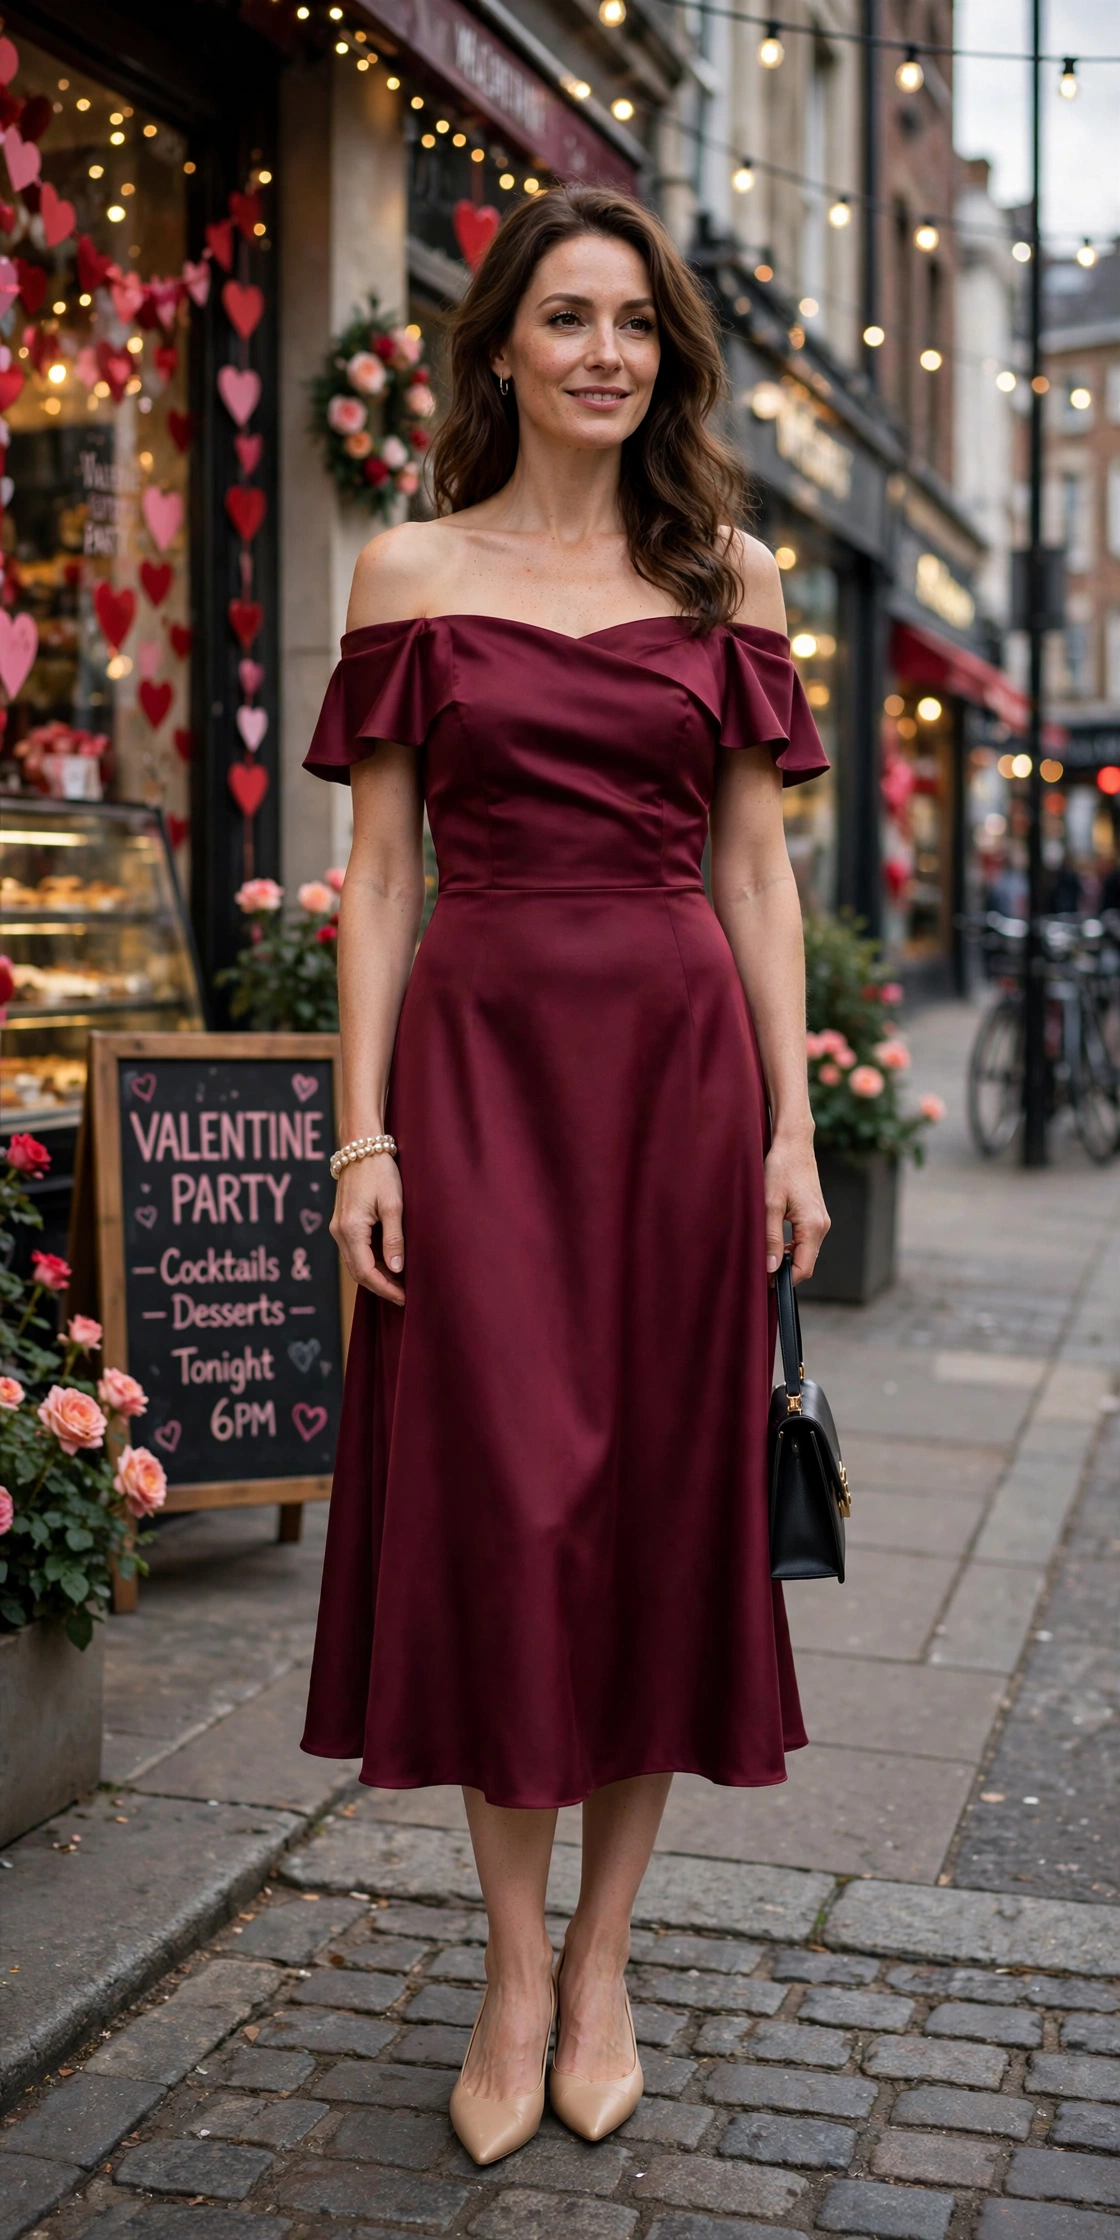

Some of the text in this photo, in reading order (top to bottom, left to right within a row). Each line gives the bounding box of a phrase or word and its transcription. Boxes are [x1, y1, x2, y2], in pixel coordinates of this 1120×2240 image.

[130, 1110, 325, 1162] VALENTINE
[171, 1173, 291, 1225] PARTY
[160, 1246, 310, 1286] Cocktails &
[172, 1293, 285, 1329] Desserts
[171, 1346, 275, 1394] Tonight
[210, 1398, 276, 1441] 6PM
